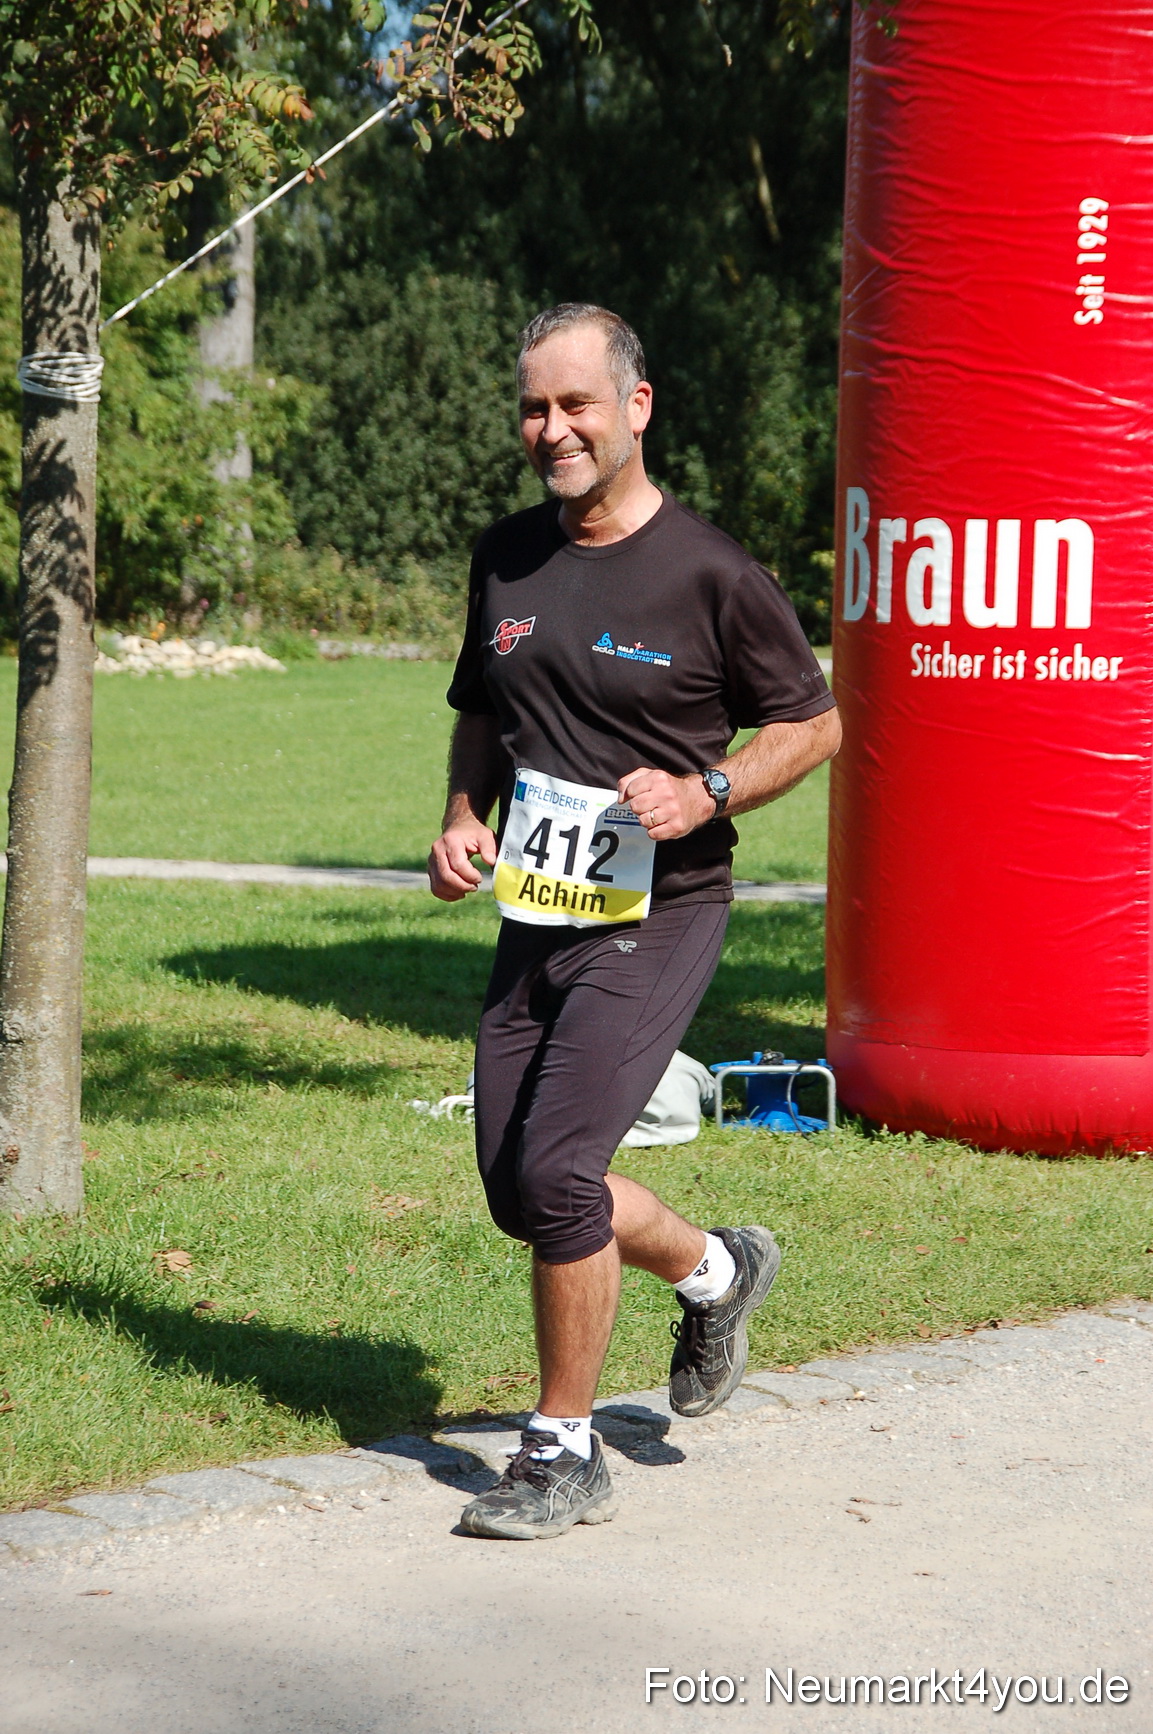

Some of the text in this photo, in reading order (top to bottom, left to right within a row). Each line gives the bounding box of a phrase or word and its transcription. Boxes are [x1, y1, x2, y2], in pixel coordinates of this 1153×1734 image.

[1073, 197, 1110, 326] Seit 1929
[843, 486, 1094, 630] Braun
[910, 641, 1123, 681] Sicher ist sicher
[527, 784, 588, 812] PFLEIDERER
[523, 817, 620, 884] 412
[518, 873, 606, 914] Achim
